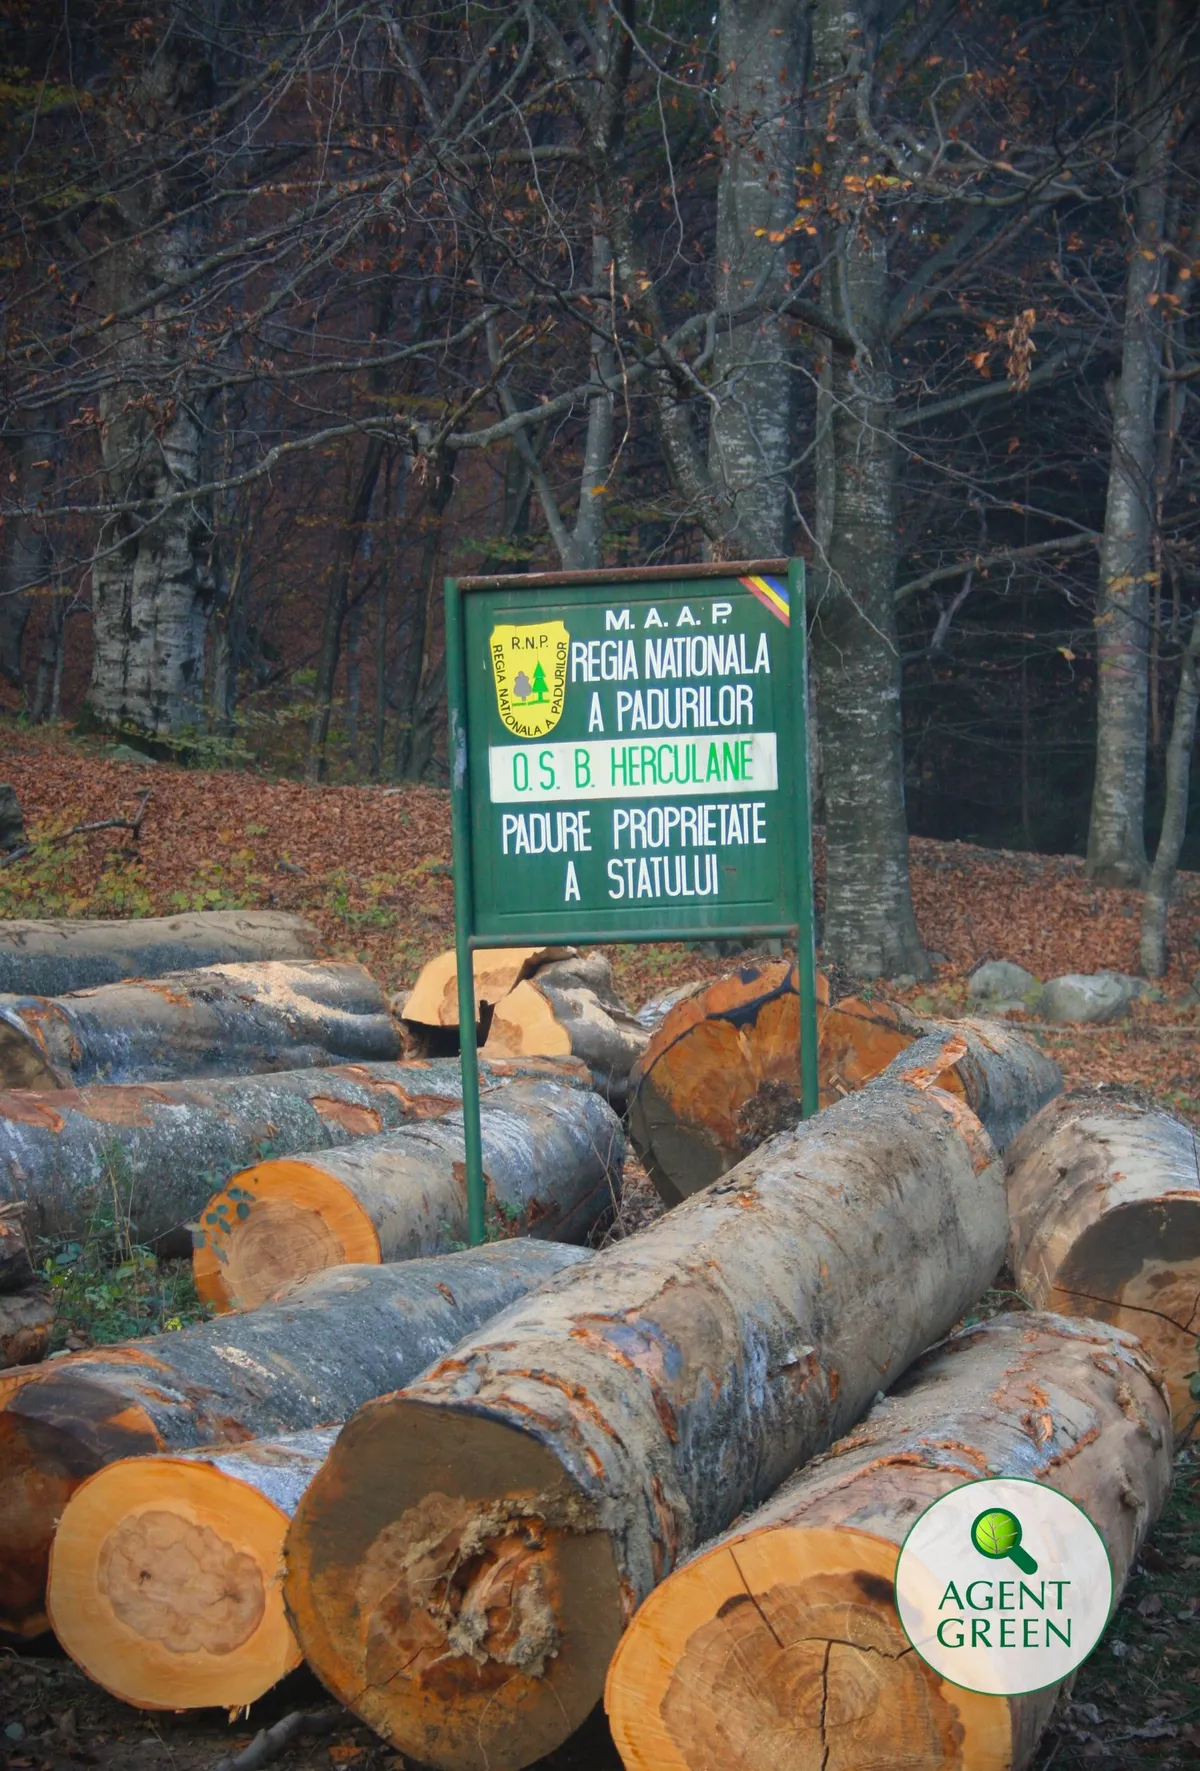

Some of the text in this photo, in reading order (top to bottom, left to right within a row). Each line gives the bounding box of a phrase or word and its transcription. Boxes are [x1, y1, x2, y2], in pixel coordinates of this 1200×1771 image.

[571, 632, 770, 682] REGIA NATIONALA
[493, 641, 567, 736] REGIA NATIONALA A PADURILOR
[588, 685, 754, 733] A PADURILOR
[610, 740, 753, 787] HERCULANE
[502, 802, 767, 855] PADURE PROPRIETATE
[564, 854, 719, 901] A STATULUI
